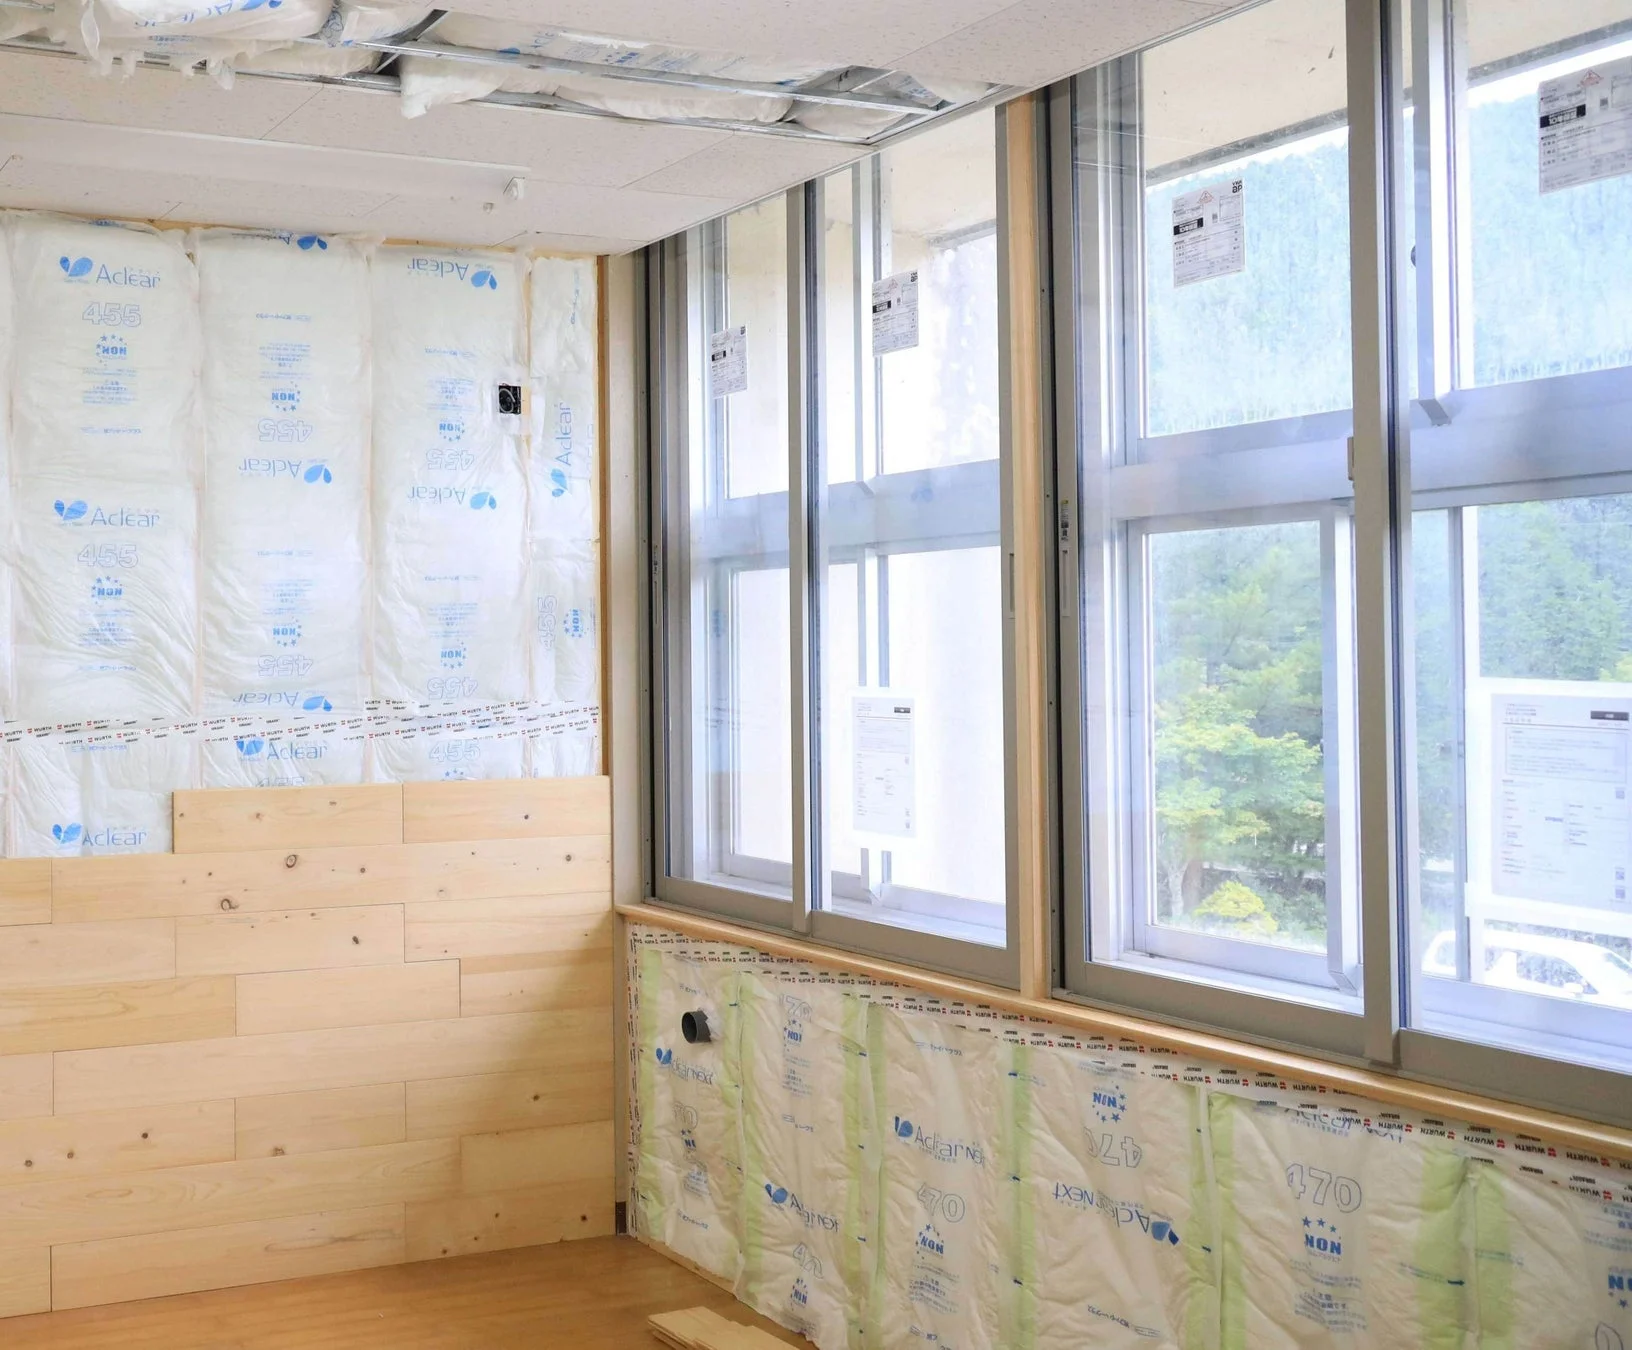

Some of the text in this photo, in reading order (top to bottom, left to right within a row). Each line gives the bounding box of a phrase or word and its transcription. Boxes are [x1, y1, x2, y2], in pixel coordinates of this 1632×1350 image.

[96, 264, 160, 288] Aclear
[407, 257, 470, 281] Aclear
[82, 302, 142, 328] 455
[101, 345, 127, 356] NON
[271, 391, 296, 402] NON
[257, 418, 314, 443] 455
[555, 402, 572, 467] Aclear
[238, 458, 302, 479] Aclear
[426, 448, 475, 471] 455
[407, 487, 467, 505] Aclear
[90, 507, 160, 527] Aclear
[77, 543, 139, 569] 455
[97, 587, 123, 597] NON
[257, 654, 314, 677] 455
[427, 675, 479, 701] 455
[233, 691, 300, 709] Aclear
[266, 741, 329, 761] Aclear
[428, 740, 481, 762] 455
[81, 828, 147, 847] Aclear
[1286, 1162, 1362, 1214] 470
[920, 1235, 945, 1255] NON
[1304, 1233, 1342, 1256] NON
